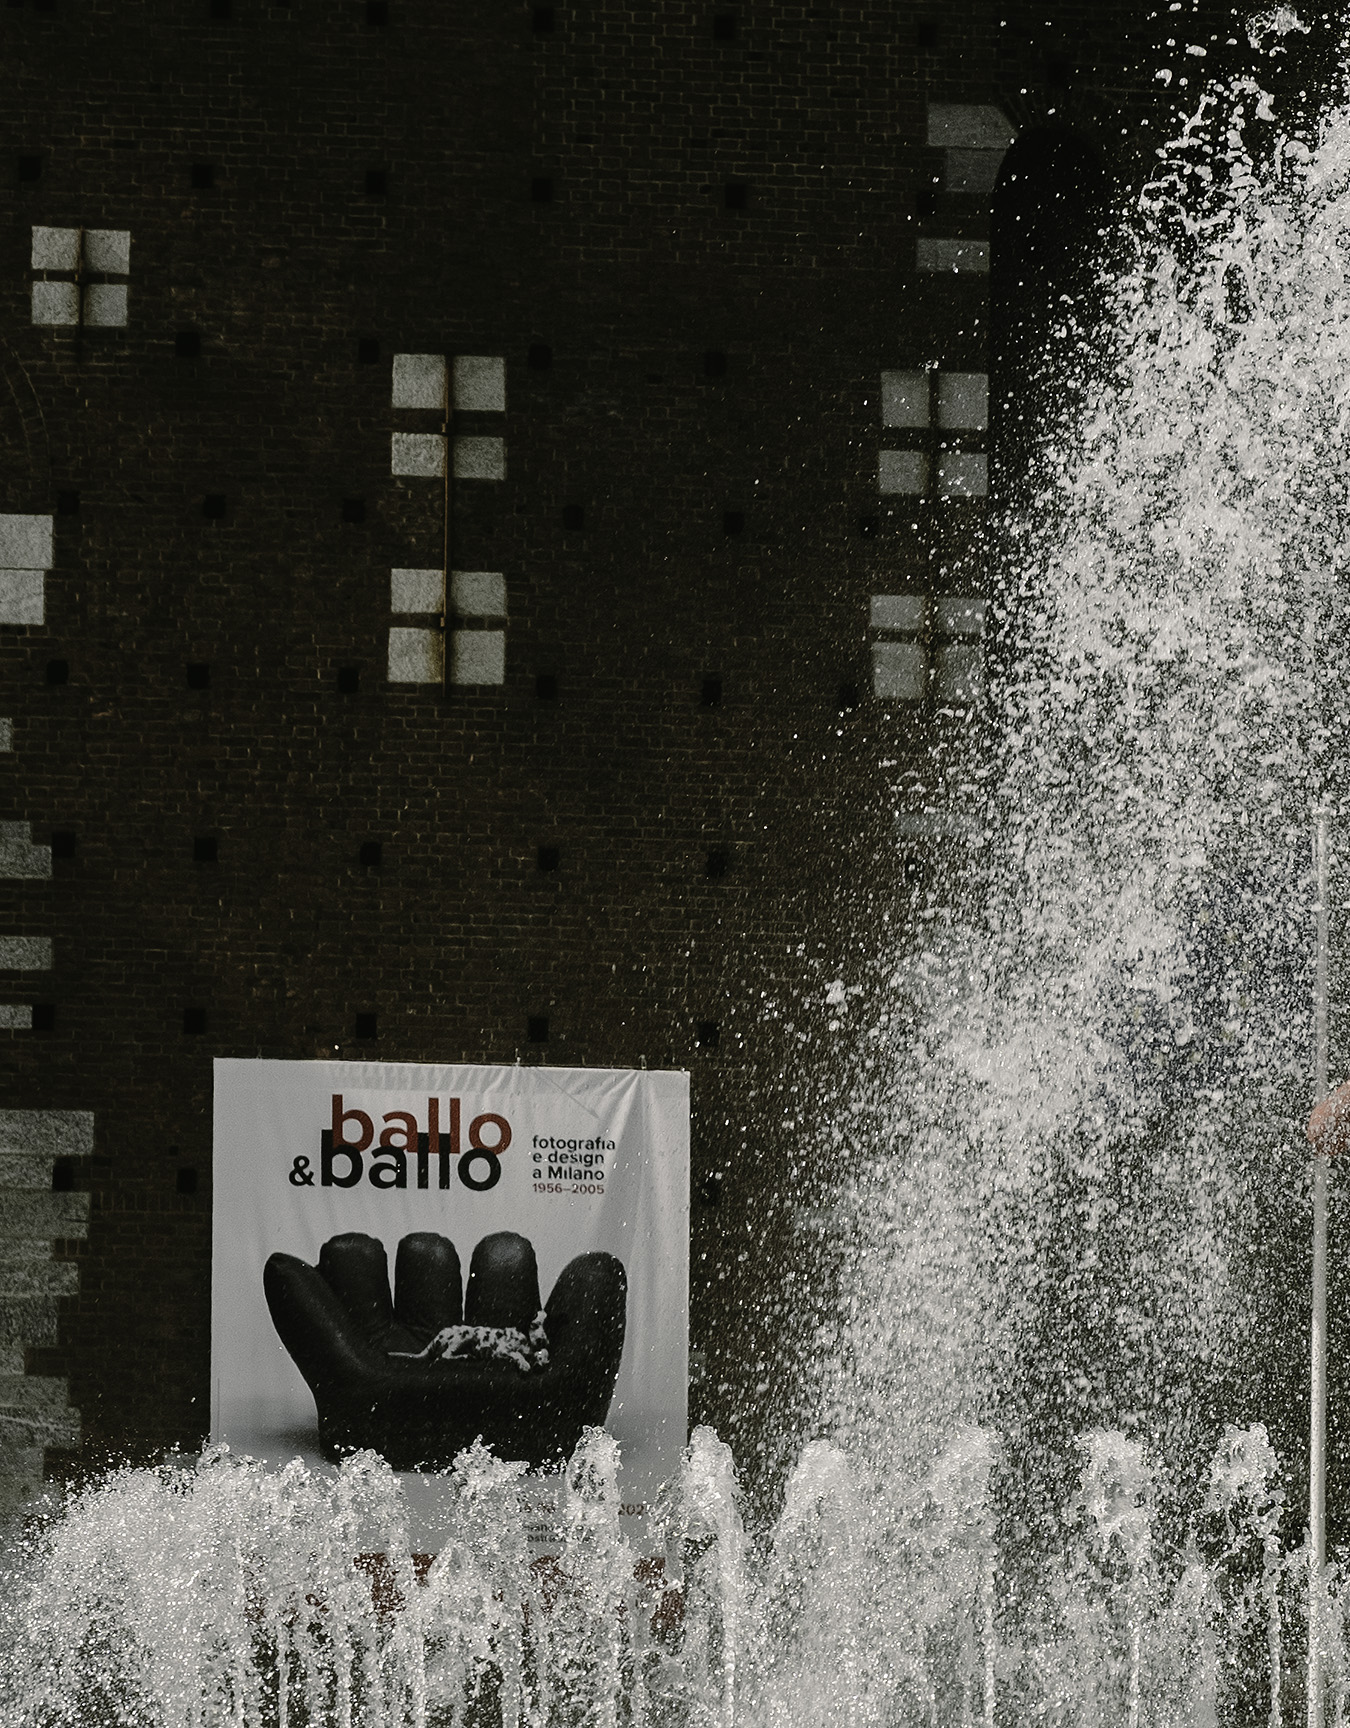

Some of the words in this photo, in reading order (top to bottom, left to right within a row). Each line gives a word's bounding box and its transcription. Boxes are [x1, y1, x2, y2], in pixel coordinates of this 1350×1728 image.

[331, 1093, 512, 1155] ballo
[532, 1134, 616, 1153] fotografia
[532, 1152, 543, 1163] e
[547, 1150, 605, 1168] design
[532, 1168, 542, 1179] a
[547, 1165, 605, 1181] Milano
[532, 1182, 605, 1195] 1956–2005
